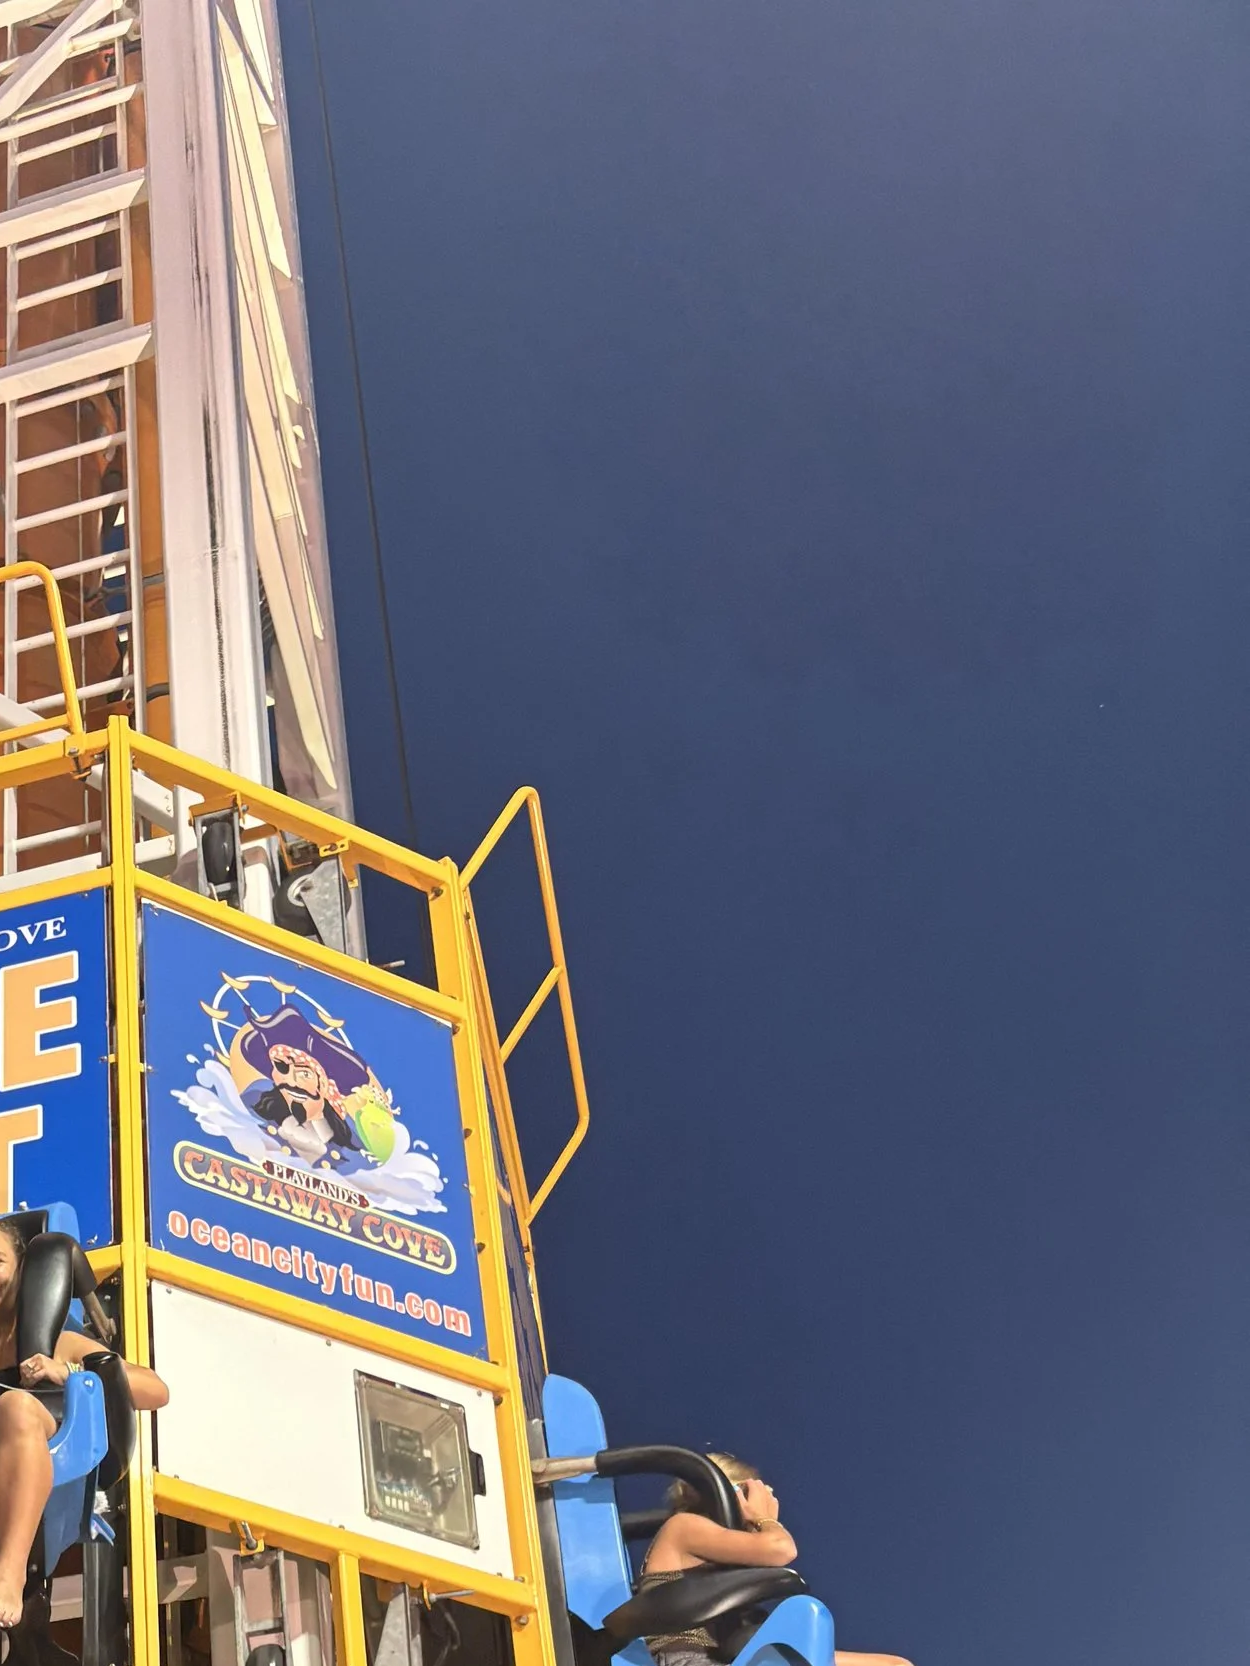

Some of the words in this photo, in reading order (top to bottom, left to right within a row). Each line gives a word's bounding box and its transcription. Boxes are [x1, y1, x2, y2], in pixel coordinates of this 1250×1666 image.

[182, 1150, 358, 1234] CASTAWAY
[361, 1213, 447, 1266] COVE
[168, 1210, 473, 1338] oceancityfun.com
